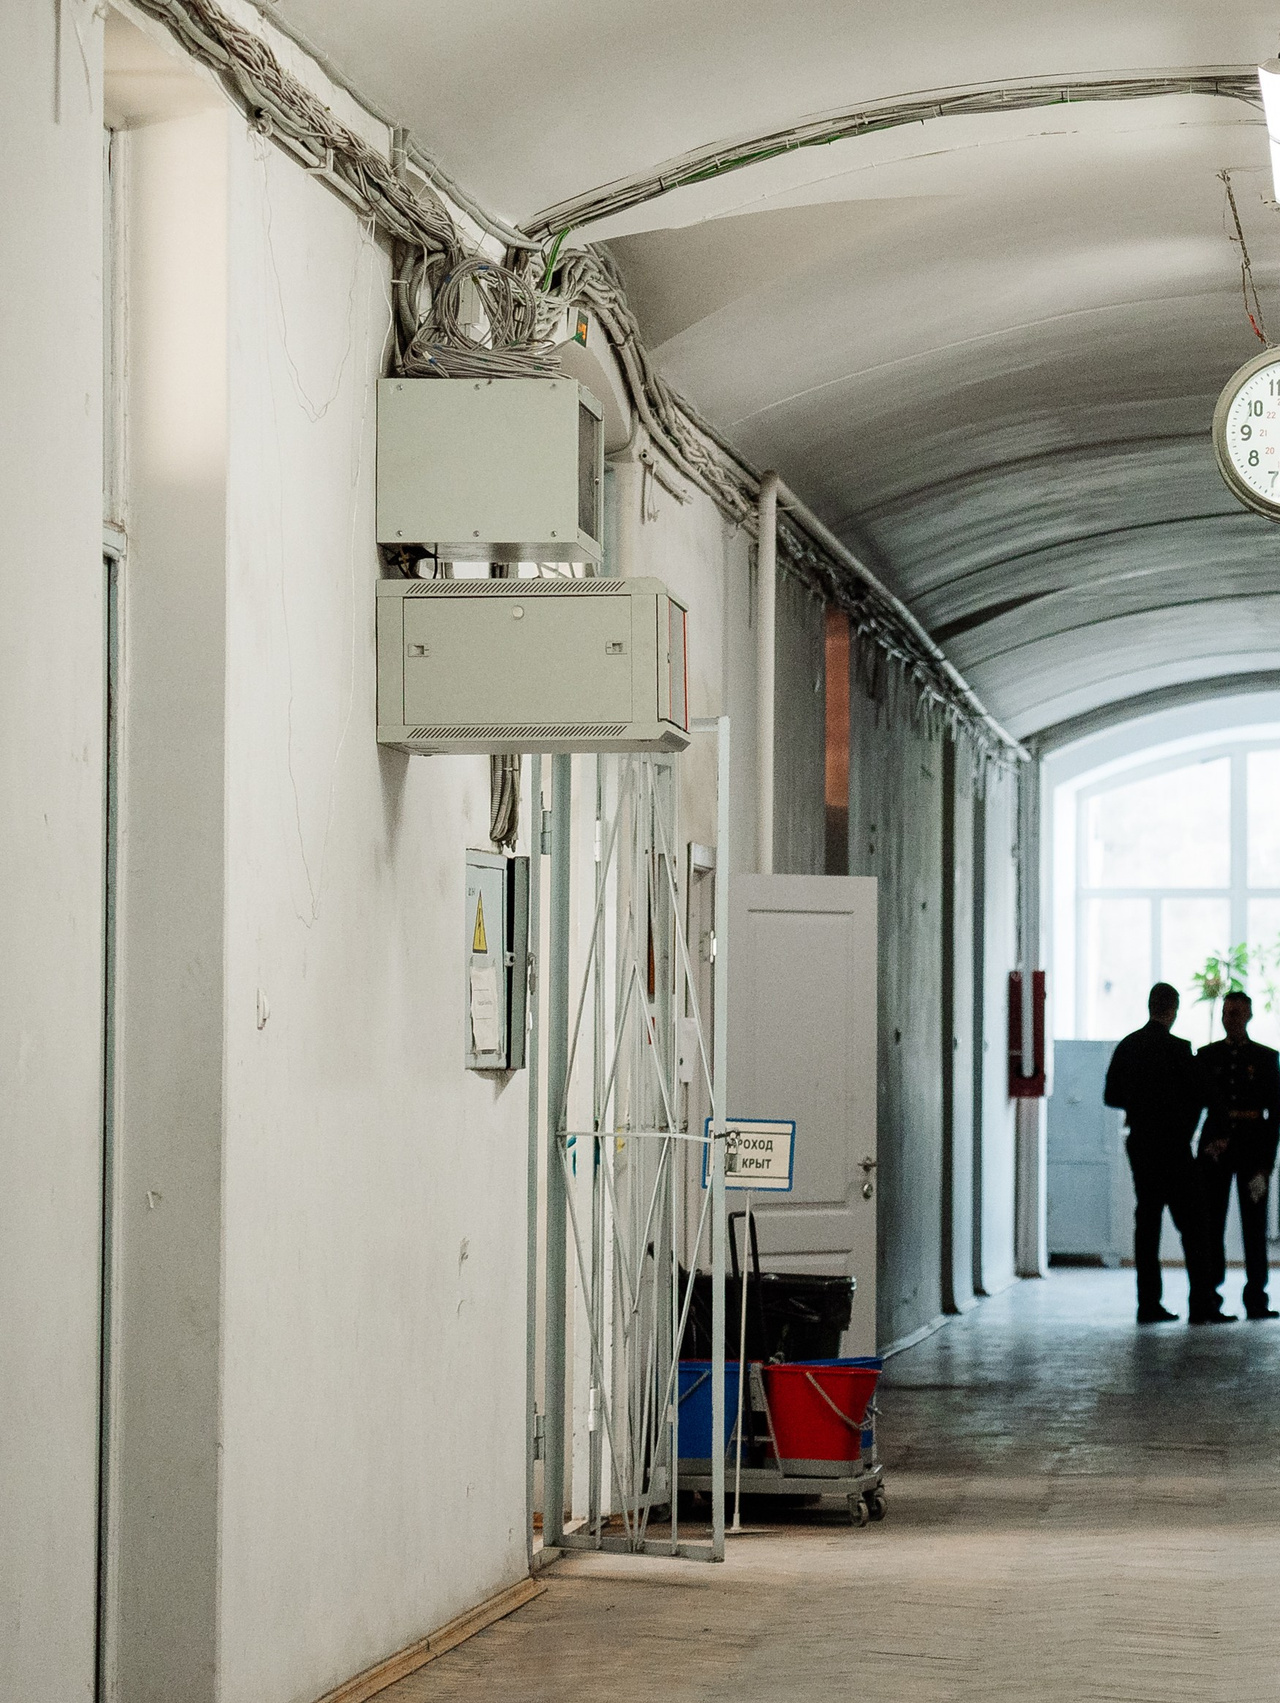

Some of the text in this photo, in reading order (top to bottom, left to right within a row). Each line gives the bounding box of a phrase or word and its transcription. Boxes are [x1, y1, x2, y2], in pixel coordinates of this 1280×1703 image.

[1248, 400, 1263, 417] 10
[1266, 411, 1276, 419] 22
[1240, 424, 1252, 441] 9
[1259, 429, 1267, 437] 21
[1248, 449, 1259, 466] 8
[1265, 447, 1275, 455] 20
[1268, 471, 1279, 488] 7
[737, 1138, 773, 1152] РОХОД
[741, 1158, 772, 1169] КРЫТ
